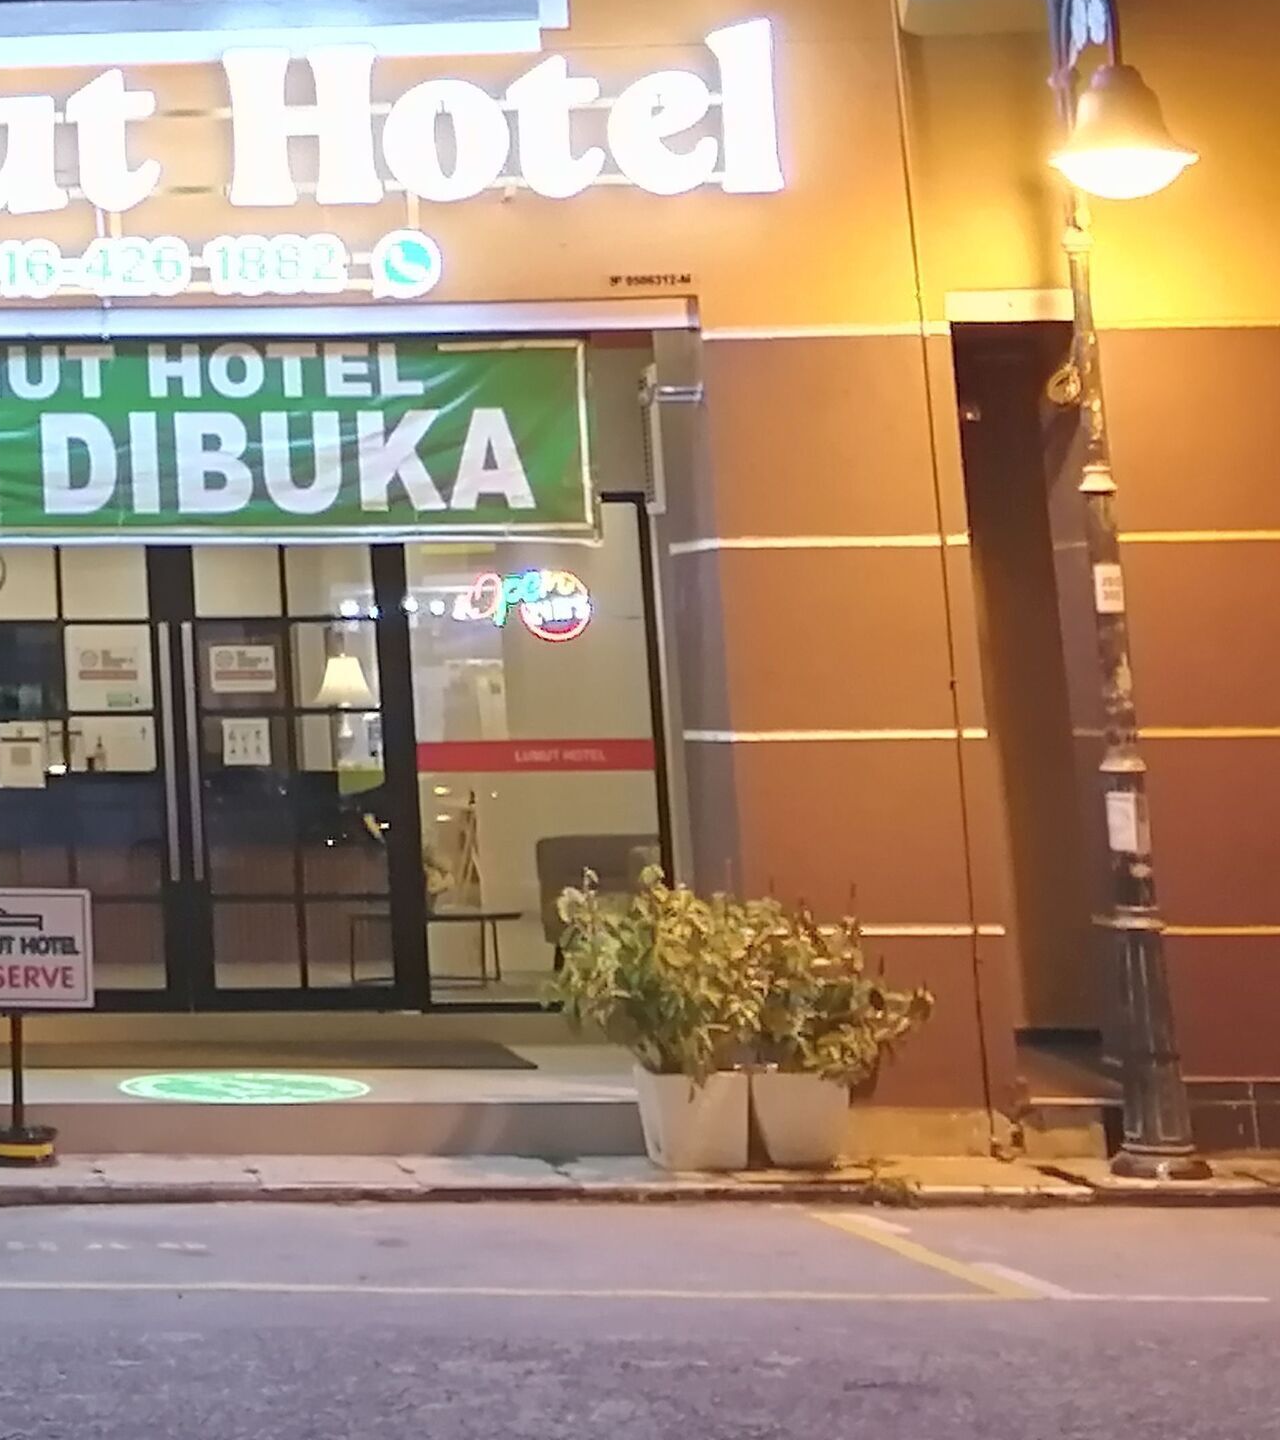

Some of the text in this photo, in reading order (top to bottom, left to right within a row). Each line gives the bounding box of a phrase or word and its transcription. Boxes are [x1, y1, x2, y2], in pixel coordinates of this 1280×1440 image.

[222, 17, 786, 210] Hotel
[150, 340, 425, 400] HOTEL
[44, 404, 538, 516] DIBUKA
[514, 748, 606, 762] LUMUT HOTEL
[20, 935, 81, 955] HOTEL
